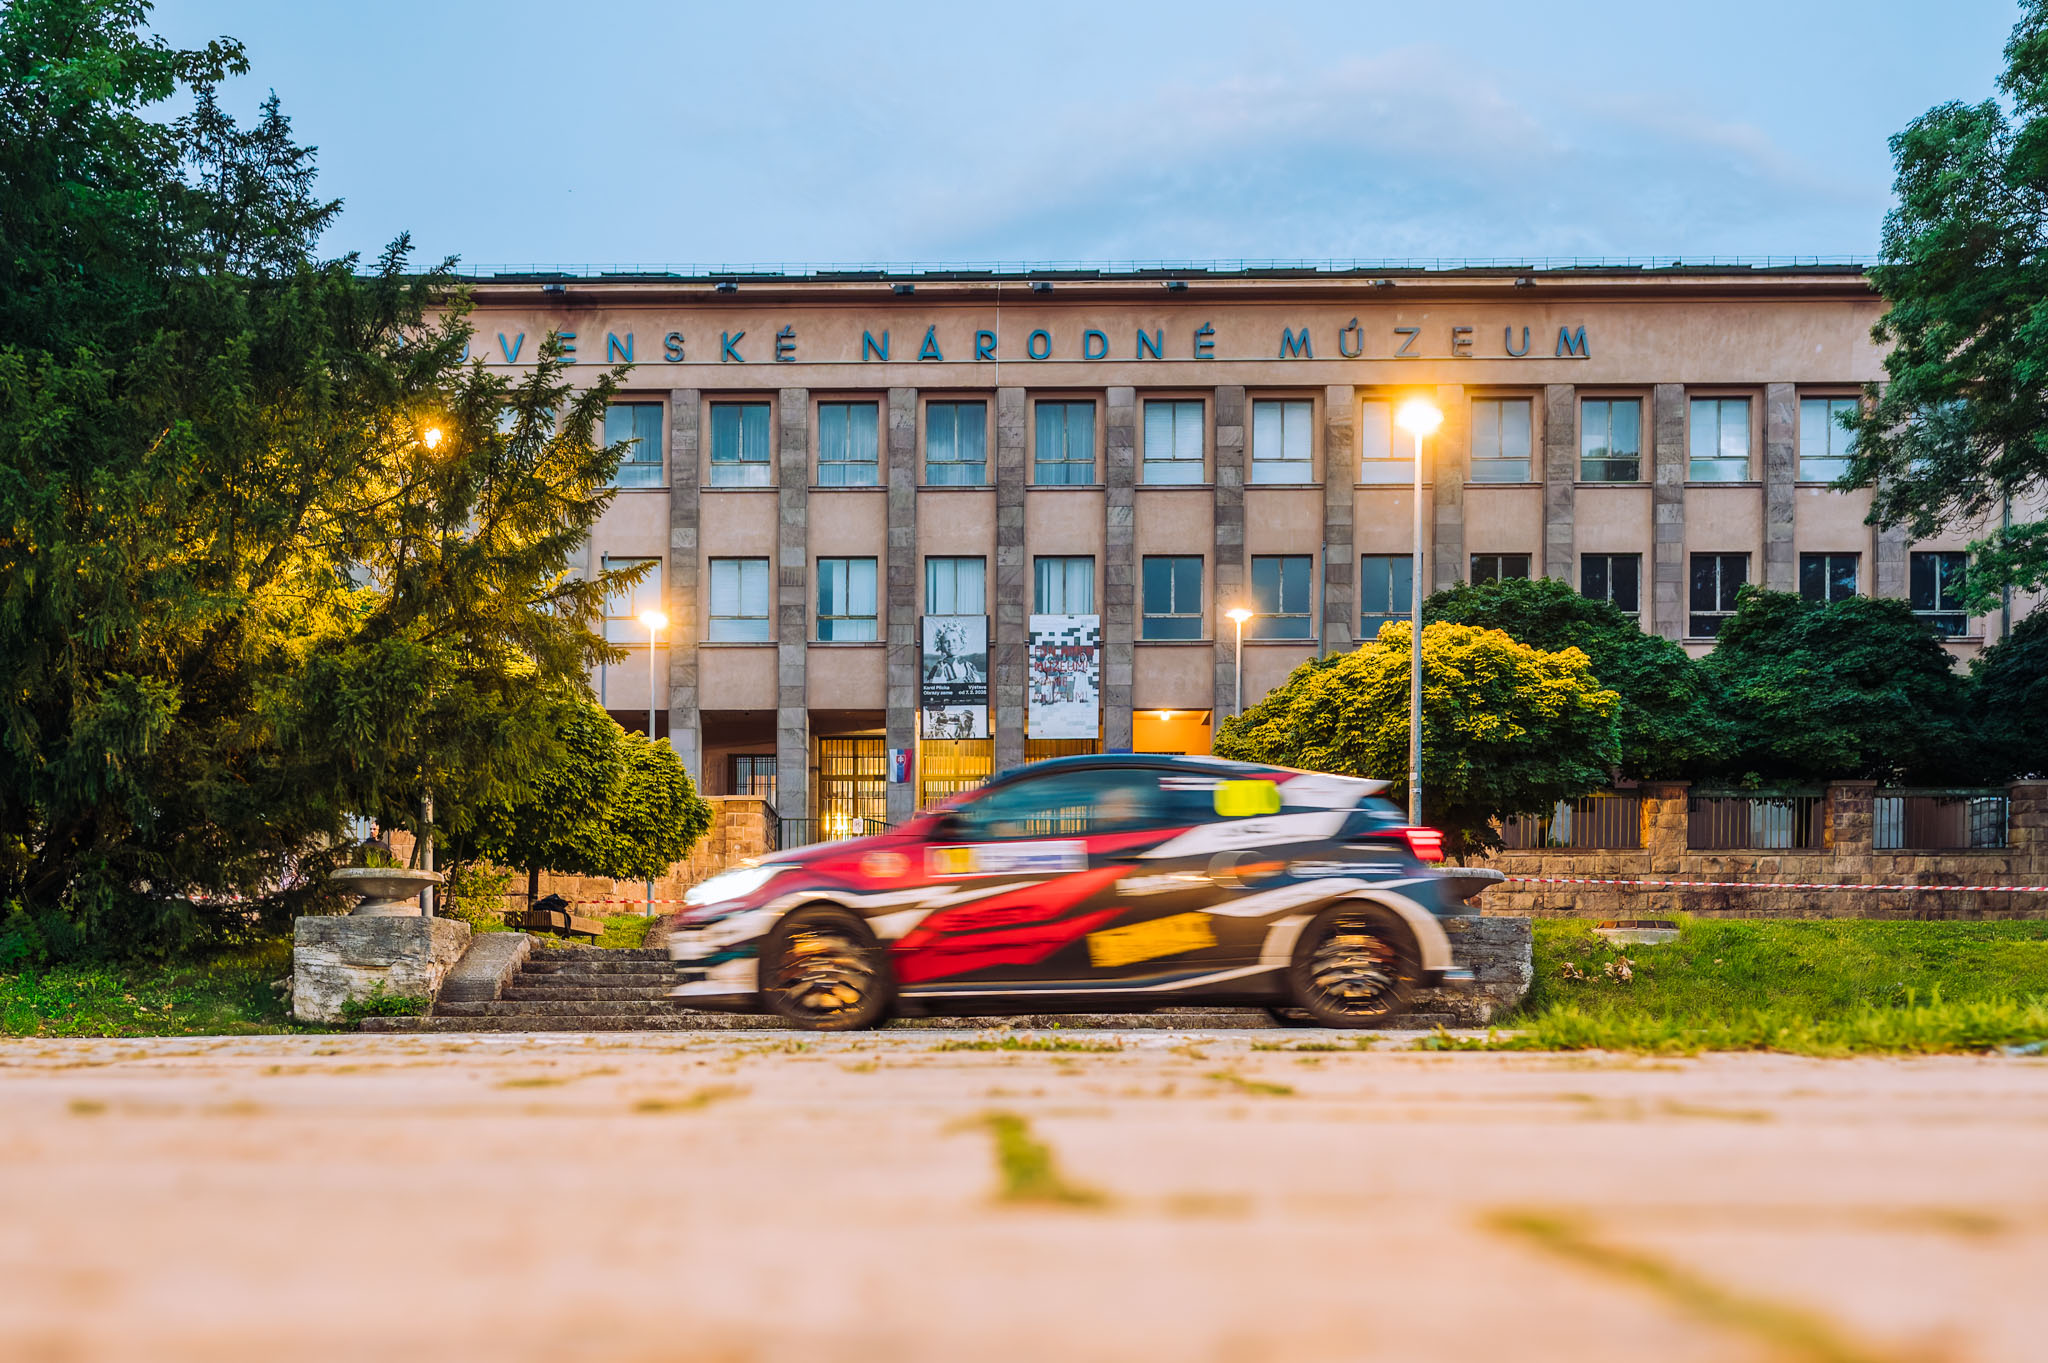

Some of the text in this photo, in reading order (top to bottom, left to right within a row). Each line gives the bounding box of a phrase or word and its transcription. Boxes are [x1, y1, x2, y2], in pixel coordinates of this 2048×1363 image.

[397, 318, 1592, 363] VENSKÉ NÁRODNÉ MÚZEUM
